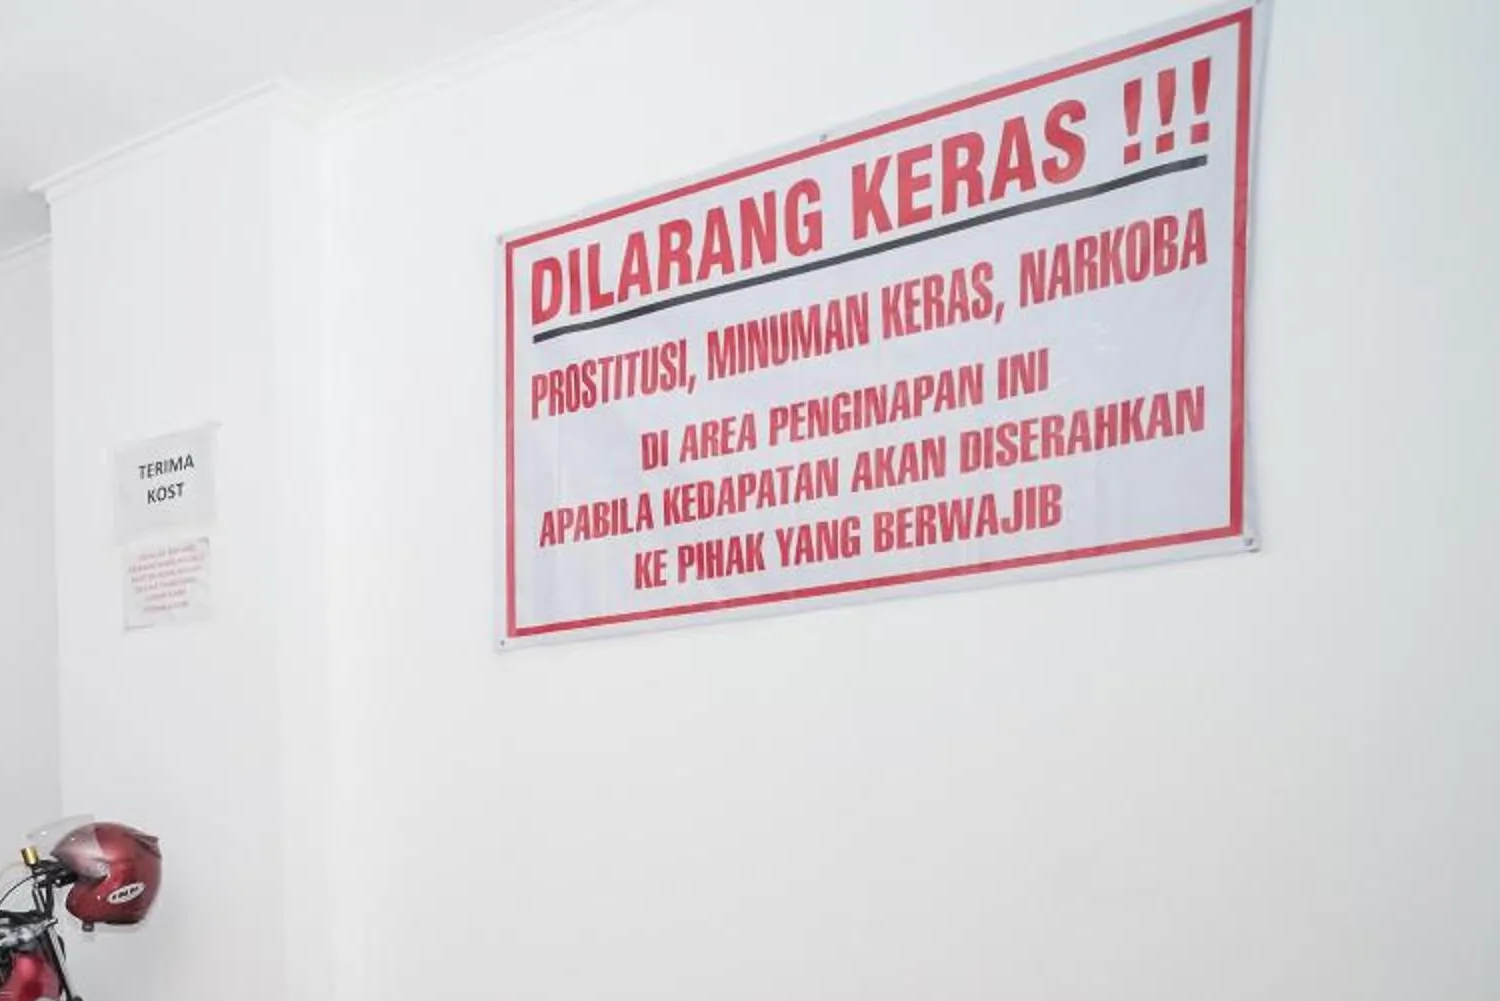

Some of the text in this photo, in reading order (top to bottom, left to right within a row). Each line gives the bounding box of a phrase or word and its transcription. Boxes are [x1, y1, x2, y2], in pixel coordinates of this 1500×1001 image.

[531, 58, 1212, 327] DILARANG KERAS !!!
[532, 209, 1209, 419] PROSTITUSI, MINUMAN KERAS, NARKOBA
[138, 453, 195, 480] TERIMA
[540, 386, 1207, 548] APABILA KEDAPATAN AKAN DISERAHKAN
[641, 349, 1049, 472] DI AREA PENGINAPAN INI
[147, 482, 185, 504] KOST
[635, 485, 1062, 590] KE PIHAK YANG BERWAJIB
